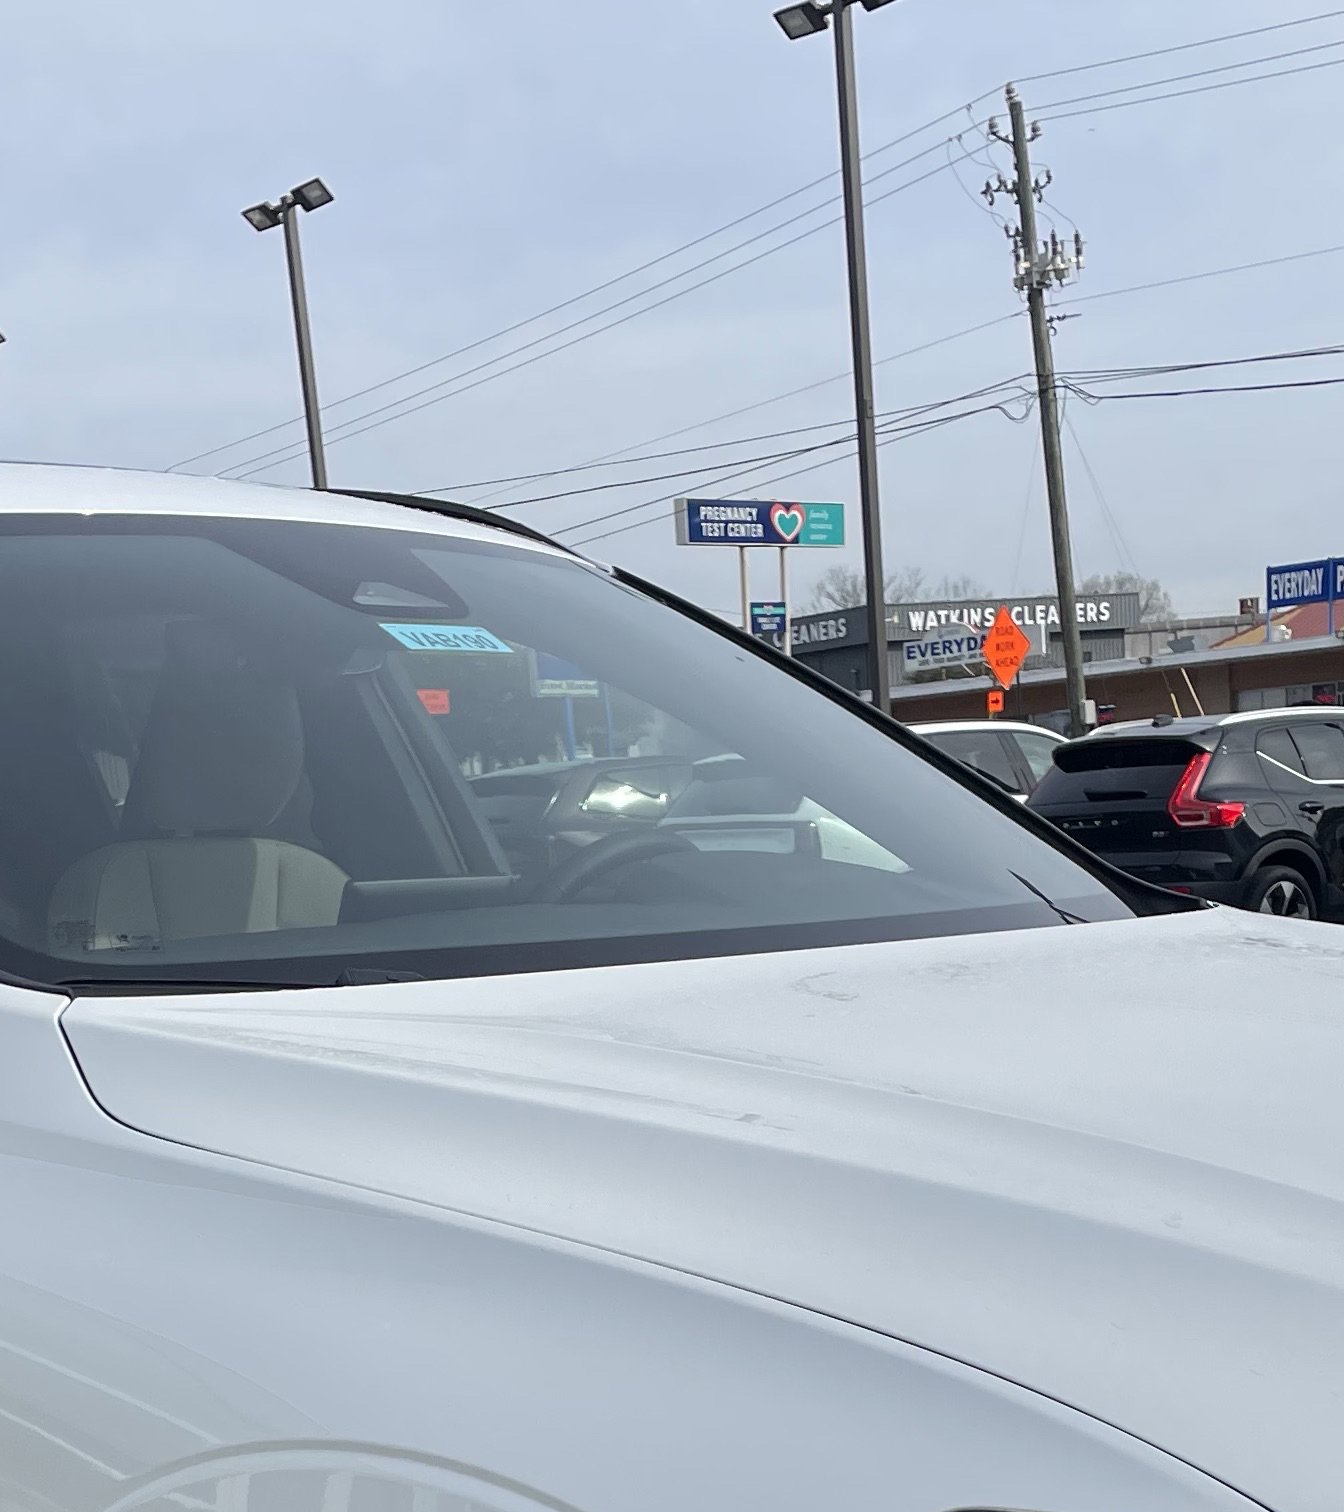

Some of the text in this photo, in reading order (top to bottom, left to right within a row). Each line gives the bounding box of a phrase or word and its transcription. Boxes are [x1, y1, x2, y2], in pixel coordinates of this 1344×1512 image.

[699, 506, 758, 521] PREGNANCY
[701, 523, 764, 537] TEST CENTER
[1271, 568, 1323, 601] EVERYDAY
[908, 602, 1111, 631] WATKINS CLEAERS
[400, 631, 499, 649] VAB190
[995, 656, 1019, 668] AHEAD
